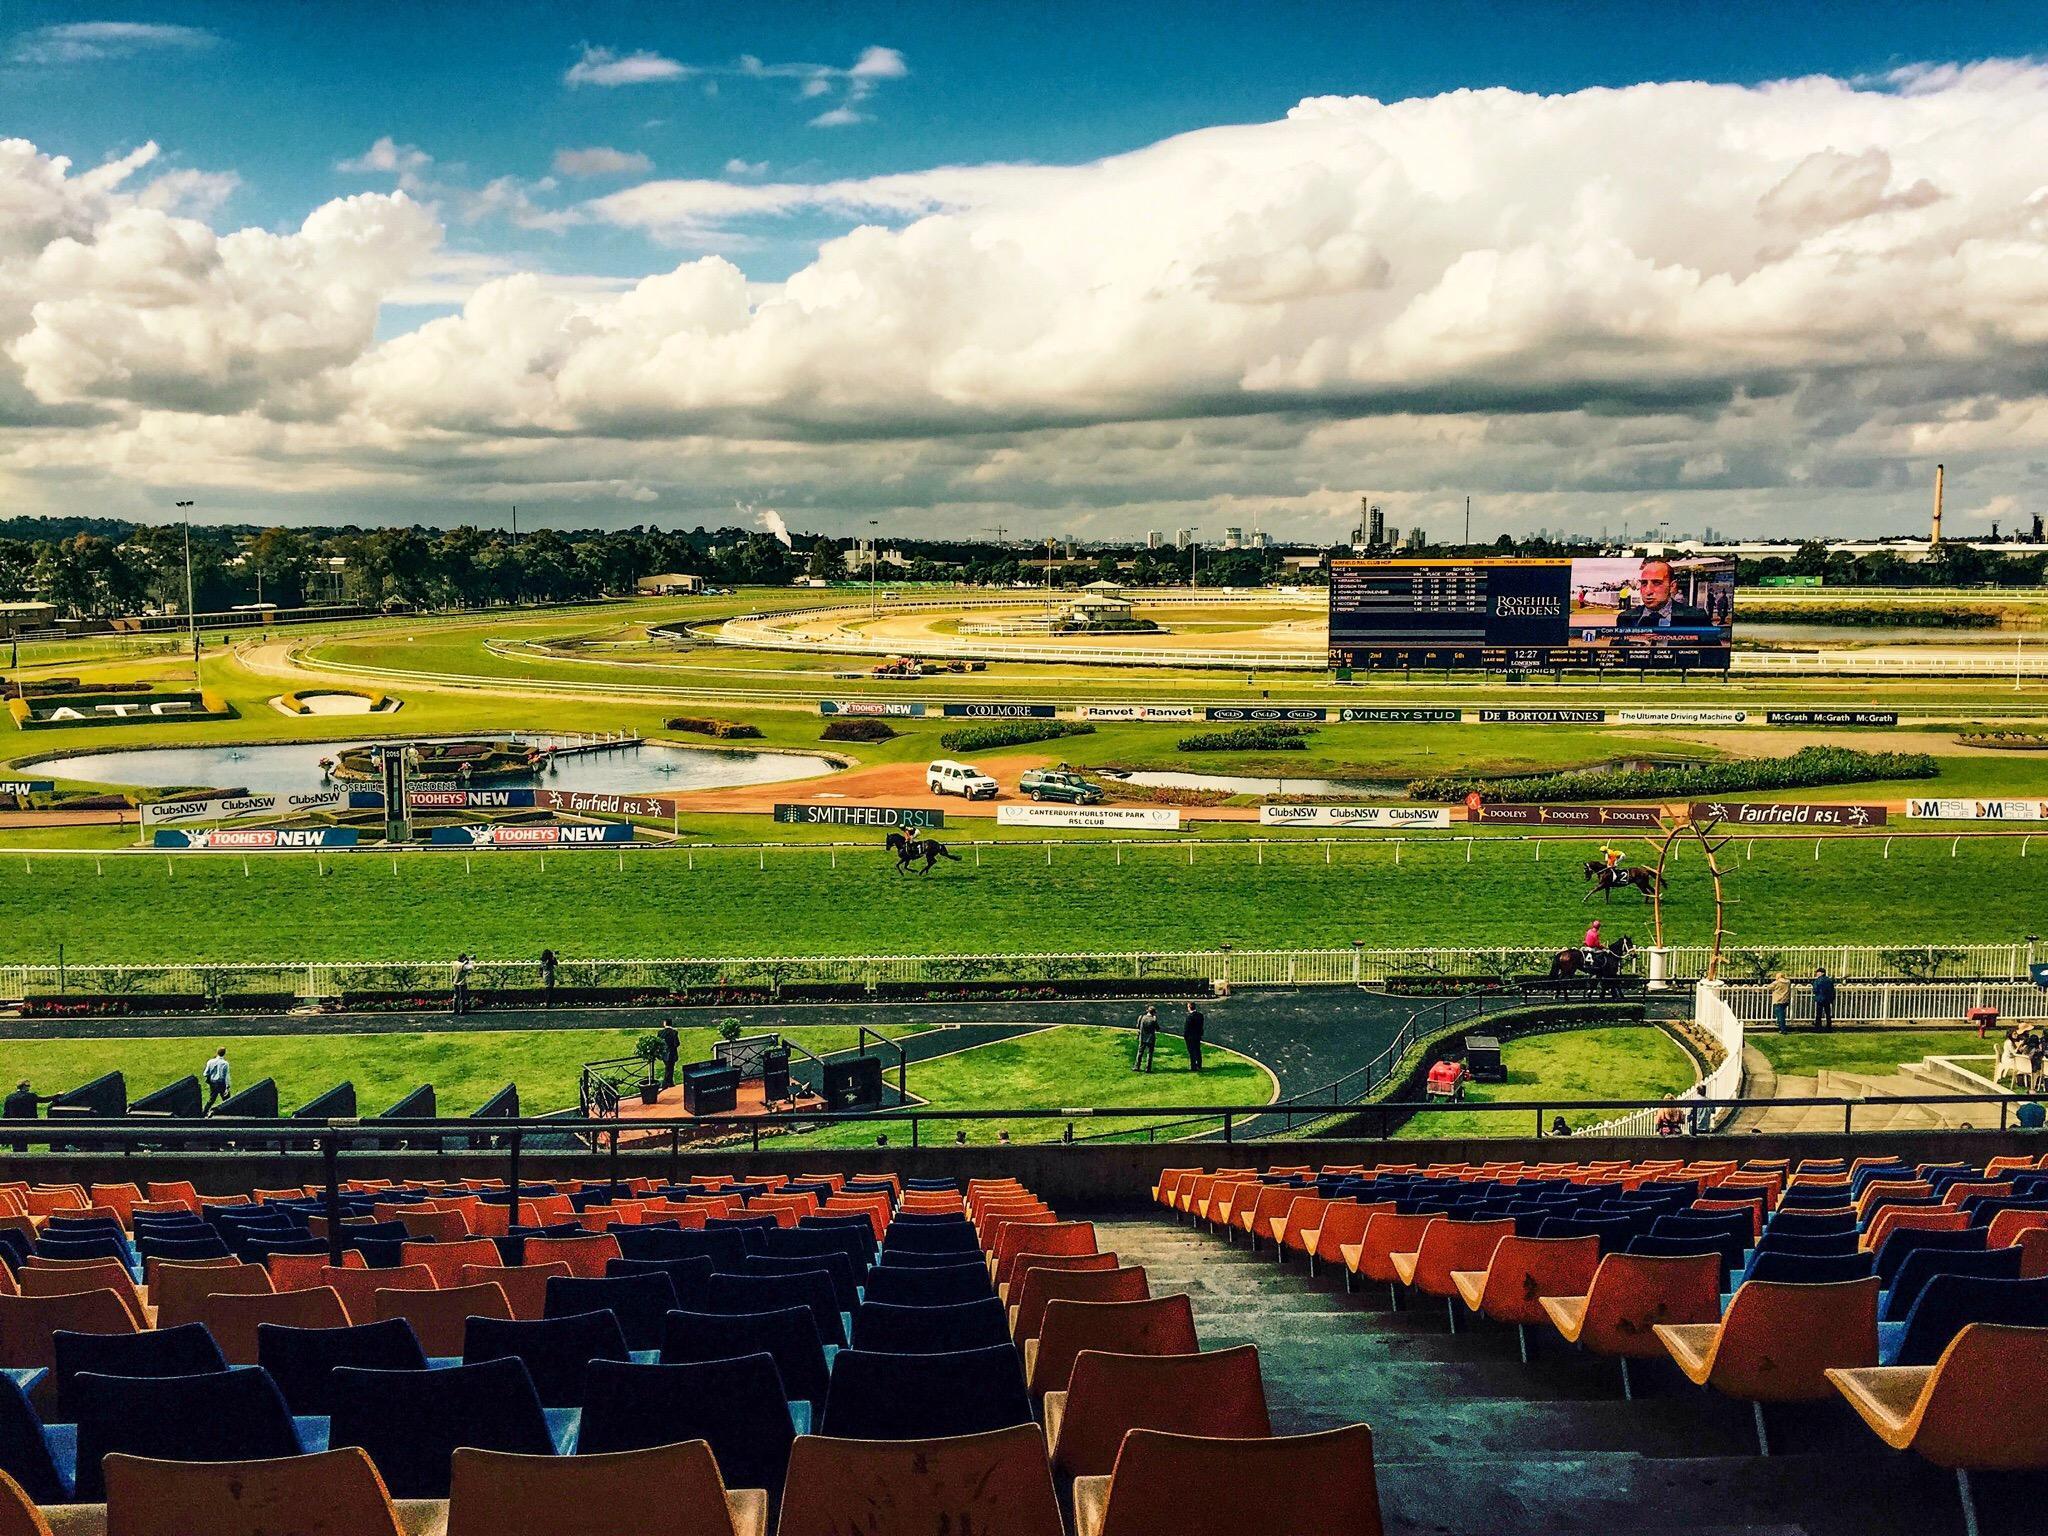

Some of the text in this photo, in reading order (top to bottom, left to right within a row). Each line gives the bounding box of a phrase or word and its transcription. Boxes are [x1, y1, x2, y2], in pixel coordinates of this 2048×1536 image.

[1497, 596, 1561, 607] ROSEHILL
[1496, 606, 1560, 616] GARDENS
[1329, 650, 1342, 658] R1
[1514, 650, 1538, 658] 12:27
[852, 704, 911, 714] TOOHEYS NEW
[966, 705, 1031, 716] COOLMORE
[1089, 708, 1134, 716] Ranvet
[1147, 708, 1192, 716] Ranvet
[1414, 711, 1455, 719] STUD
[1507, 711, 1557, 721] BORTOLI
[1561, 711, 1599, 721] WINES
[1621, 712, 1732, 721] The Ultimate Driving Machine
[1772, 713, 1808, 721] McGrath
[1814, 713, 1850, 721] McGrath
[1856, 714, 1892, 722] McGrath
[407, 782, 456, 791] GARDENS
[288, 792, 340, 805] ClubsNSW
[411, 792, 509, 805] TOOHEYS NEW
[152, 803, 208, 815] ClubsNSW
[221, 797, 275, 811] ClubsNSW
[570, 793, 642, 815] fairfield RSL
[1940, 801, 1969, 810] RSL
[2004, 802, 2032, 811] RSL
[808, 806, 934, 827] SMITHFIELD RSL
[1029, 809, 1078, 817] CANTERBURY
[1080, 810, 1123, 818] HURLSTONE
[1268, 807, 1317, 817] ClubsNSW
[1330, 808, 1379, 818] ClubsNSW
[1389, 809, 1439, 819] ClubsNSW
[1490, 810, 1527, 818] DOOLEYS
[1552, 811, 1589, 820] DOOLEYS
[1612, 812, 1649, 821] DOOLEYS
[1739, 803, 1841, 823] fairfield RSL
[213, 831, 325, 846] TOOHEYS NEW
[498, 826, 606, 842] TOOHEYS NEW
[1620, 871, 1628, 881] 2
[1586, 953, 1594, 965] 4
[848, 1077, 853, 1087] 1
[313, 1139, 320, 1149] 3
